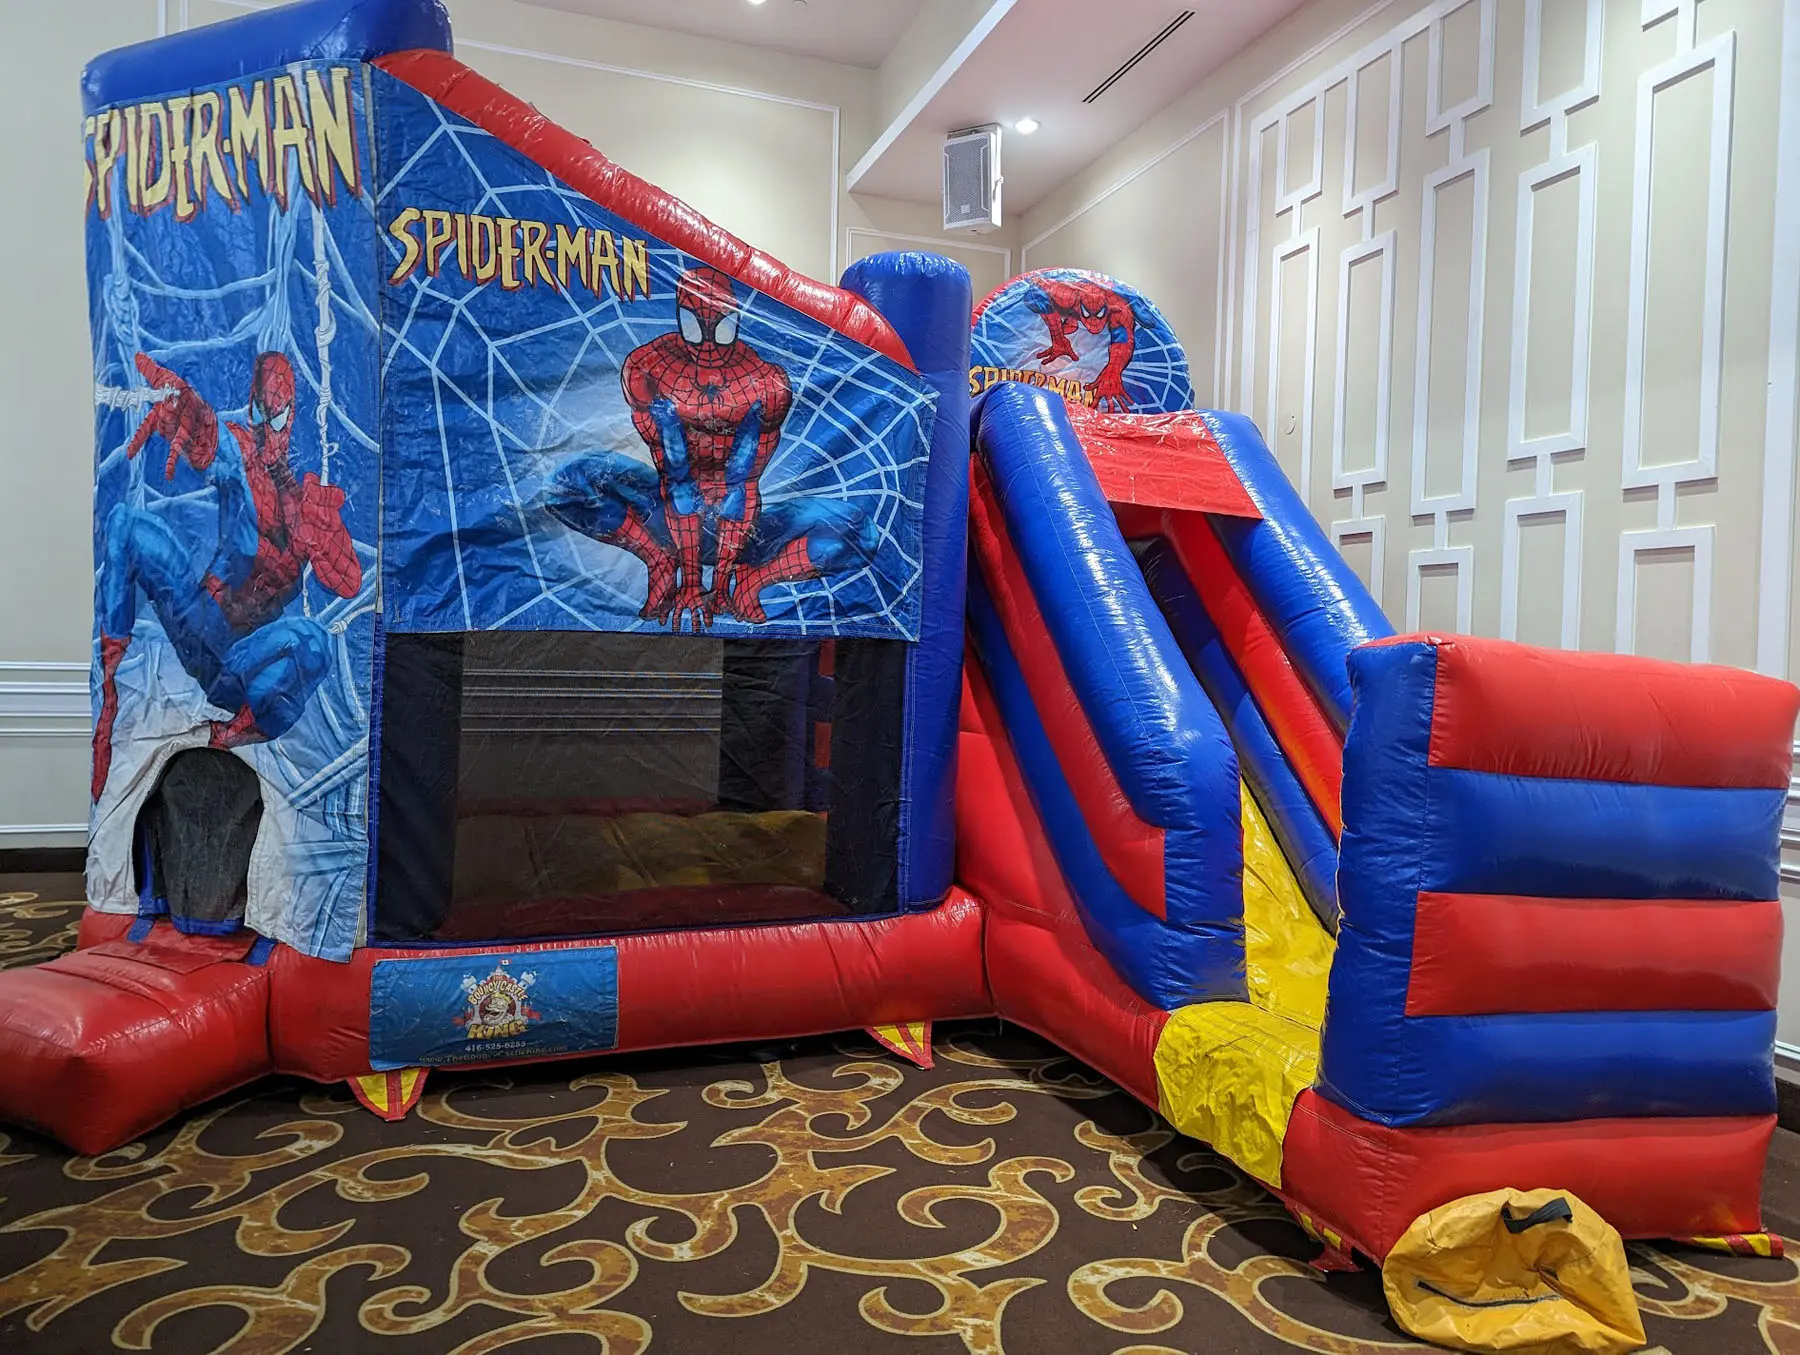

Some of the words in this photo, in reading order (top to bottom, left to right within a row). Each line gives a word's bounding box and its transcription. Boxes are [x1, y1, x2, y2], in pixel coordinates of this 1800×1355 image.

[388, 207, 652, 303] SPIDER-MAN
[969, 365, 1098, 408] SPRMAN
[467, 980, 499, 1005] BOUNCY
[499, 980, 529, 1001] CASTLE
[467, 1020, 527, 1039] KING
